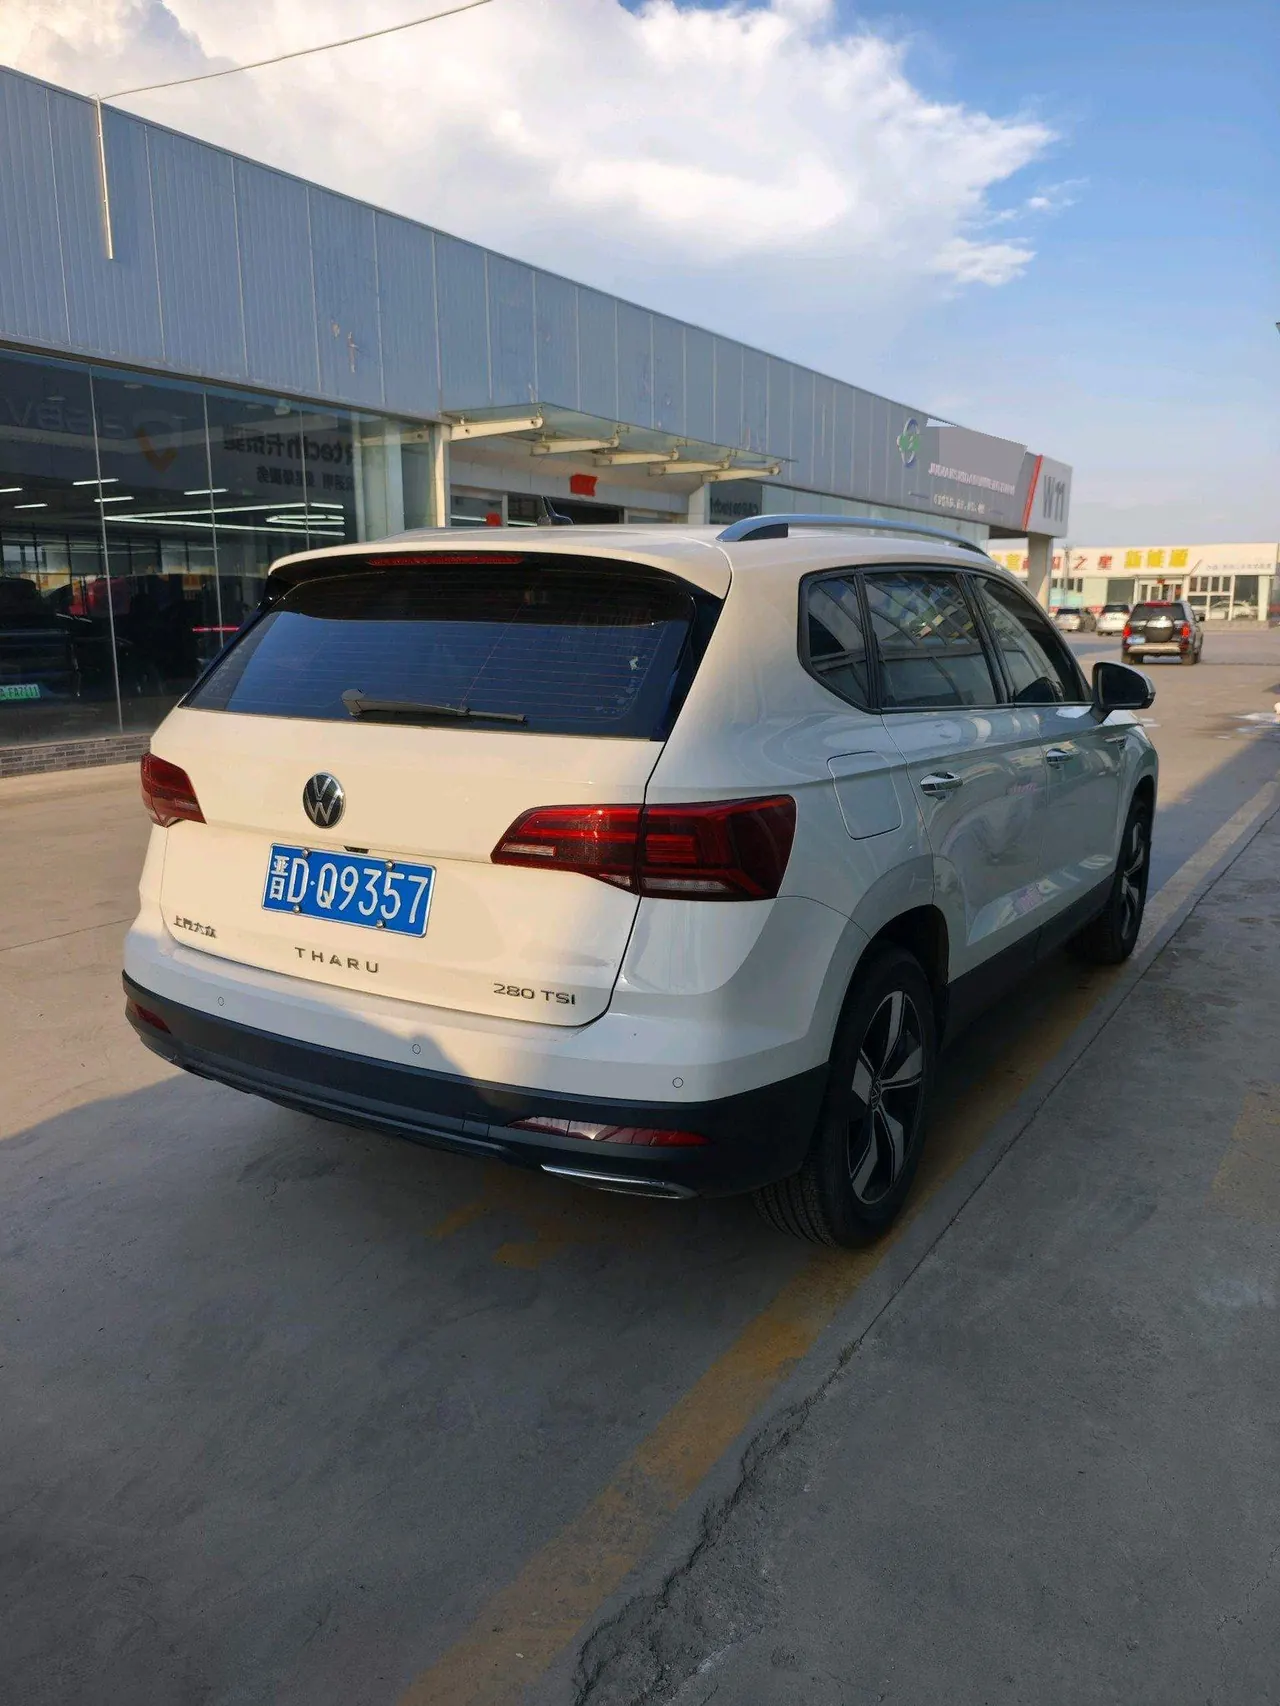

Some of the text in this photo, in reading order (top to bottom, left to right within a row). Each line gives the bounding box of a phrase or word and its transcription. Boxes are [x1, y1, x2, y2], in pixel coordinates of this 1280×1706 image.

[294, 946, 381, 974] THARU
[492, 982, 576, 1006] 280 TSI
